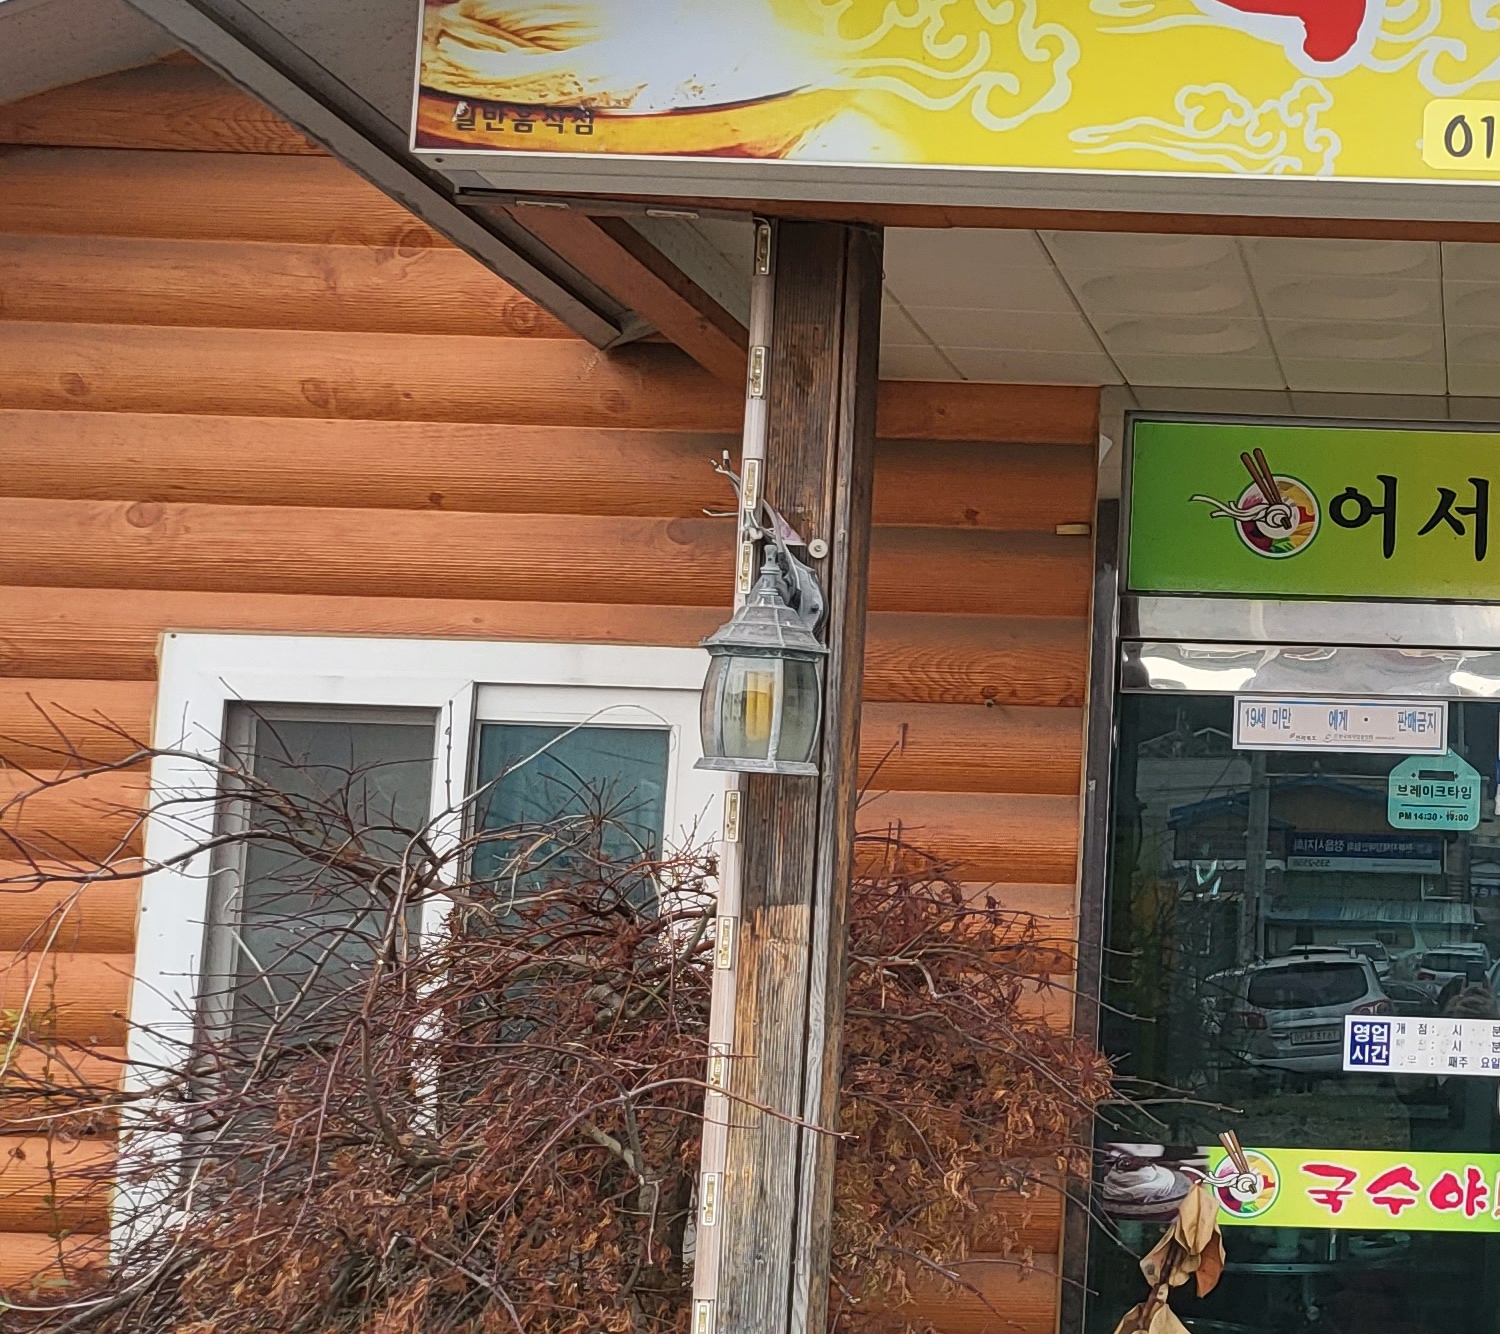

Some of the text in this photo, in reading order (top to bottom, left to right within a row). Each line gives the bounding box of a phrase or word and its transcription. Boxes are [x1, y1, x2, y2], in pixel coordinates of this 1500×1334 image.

[1245, 706, 1438, 734] 19세 미만 에게 판매금지
[1396, 783, 1472, 800] 브레이크타임
[1398, 811, 1412, 820] PM
[1352, 1023, 1389, 1043] 영업
[1451, 1024, 1463, 1037] 시
[1351, 1044, 1389, 1064] 시간
[1451, 1040, 1462, 1053] 시
[1480, 1057, 1500, 1070] 요일
